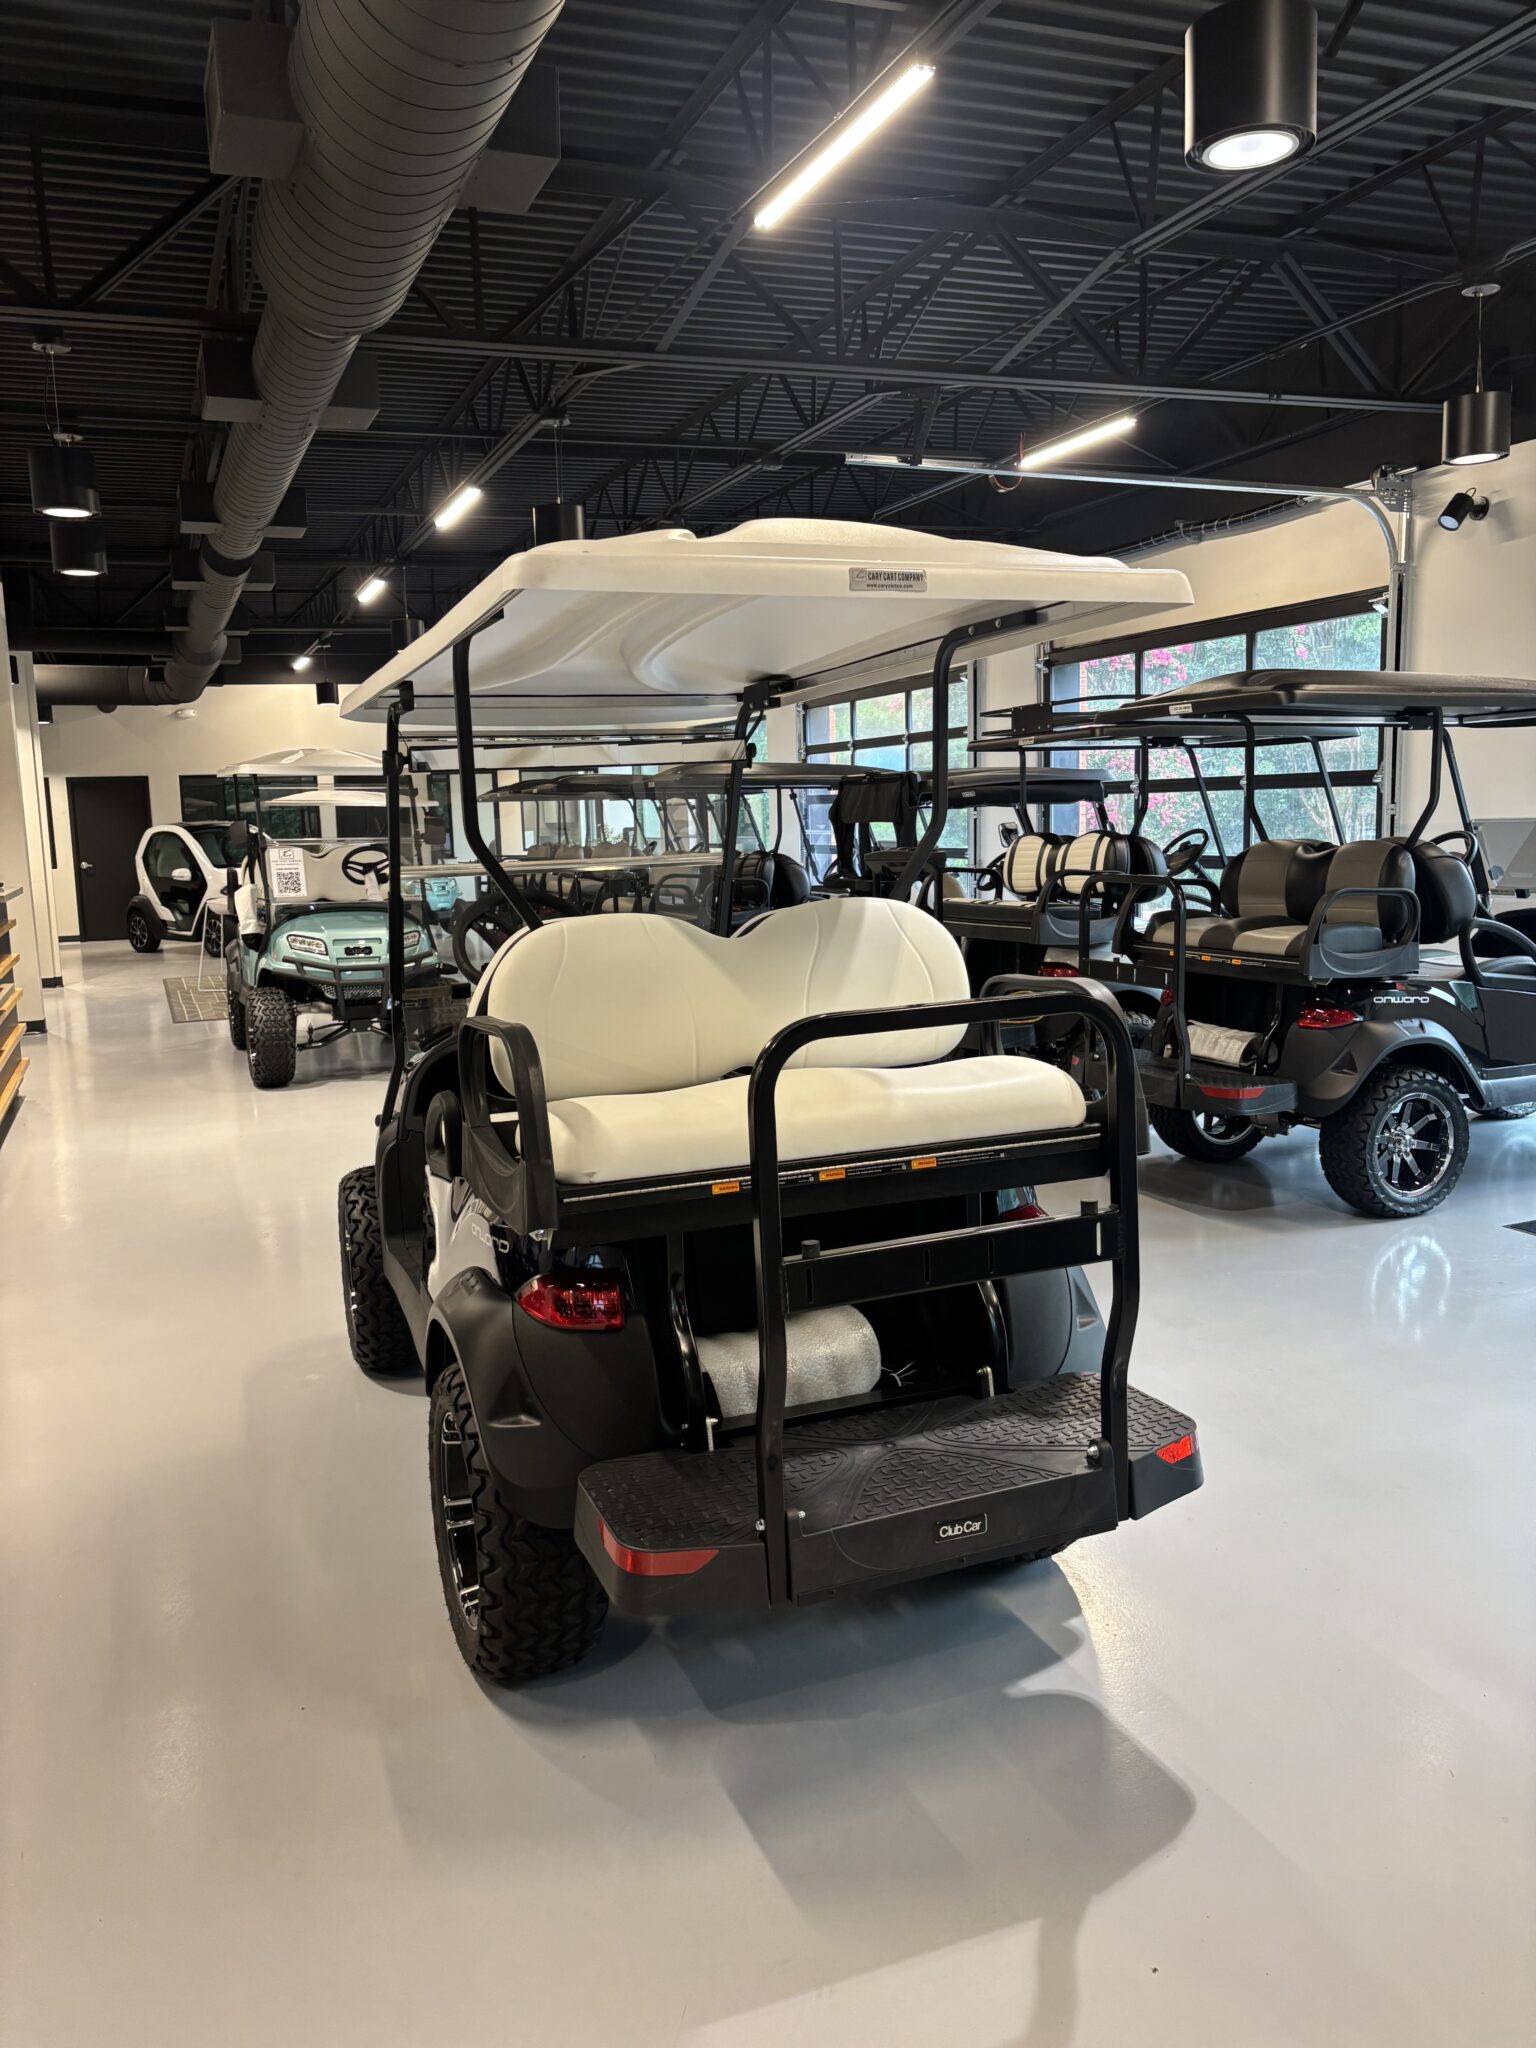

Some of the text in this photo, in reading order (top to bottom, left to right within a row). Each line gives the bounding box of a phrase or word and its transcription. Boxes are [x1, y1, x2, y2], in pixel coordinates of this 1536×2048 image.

[868, 571, 924, 582] CARY CART COMPANY
[939, 1520, 982, 1538] Club Car
